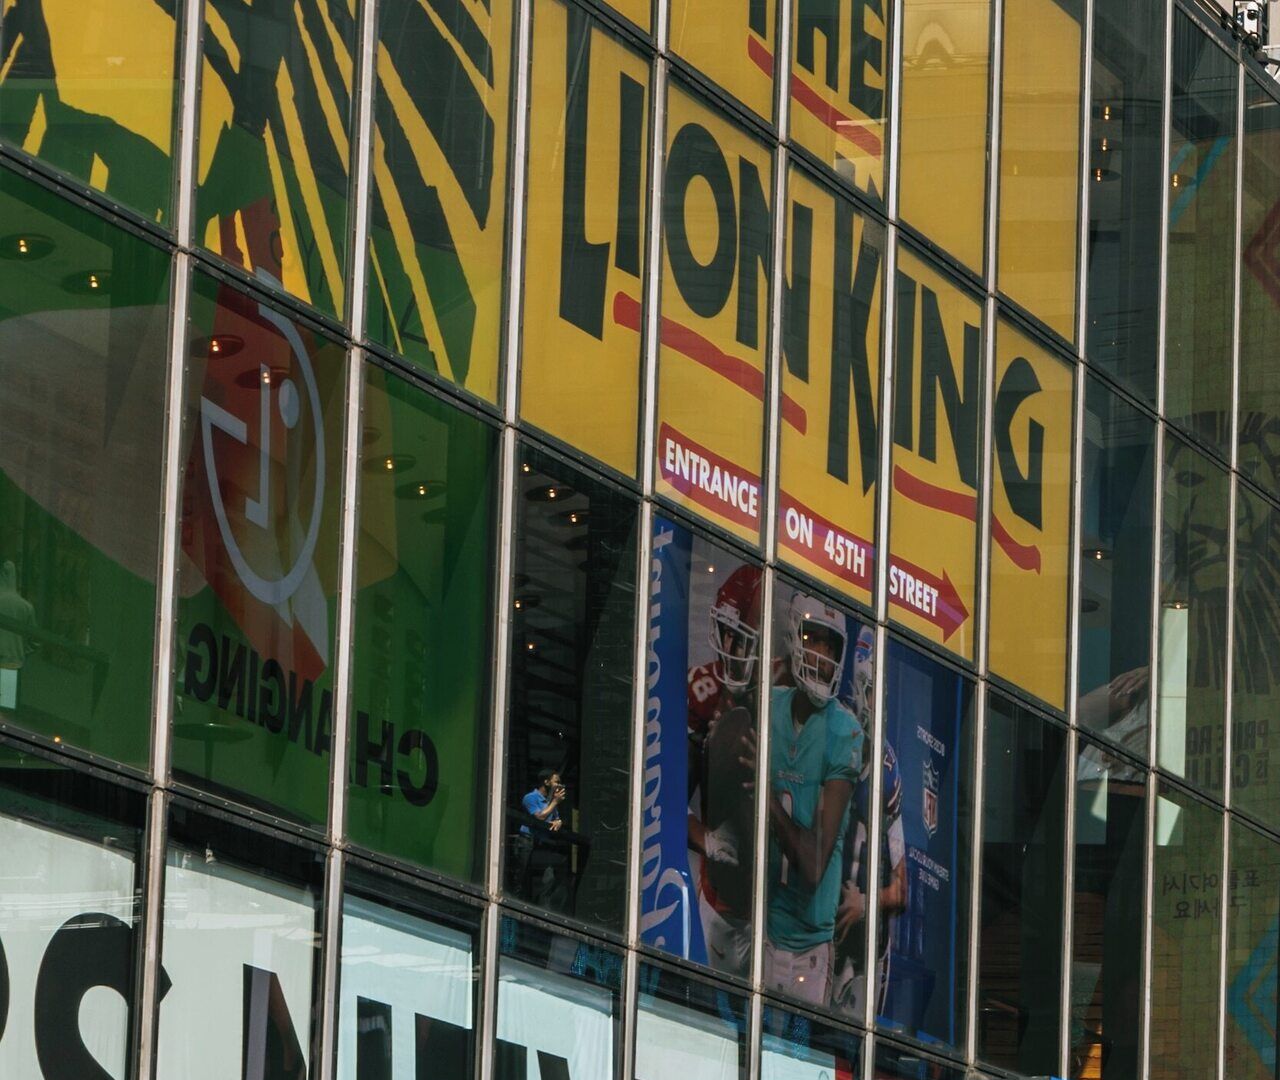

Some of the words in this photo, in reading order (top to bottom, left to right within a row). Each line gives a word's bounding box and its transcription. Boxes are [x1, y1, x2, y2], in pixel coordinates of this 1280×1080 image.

[559, 8, 813, 384] LION
[826, 153, 1043, 532] KING
[664, 438, 758, 518] ENTRANCE
[785, 507, 813, 549] ON
[823, 531, 866, 579] 45TH
[888, 565, 940, 618] STREET
